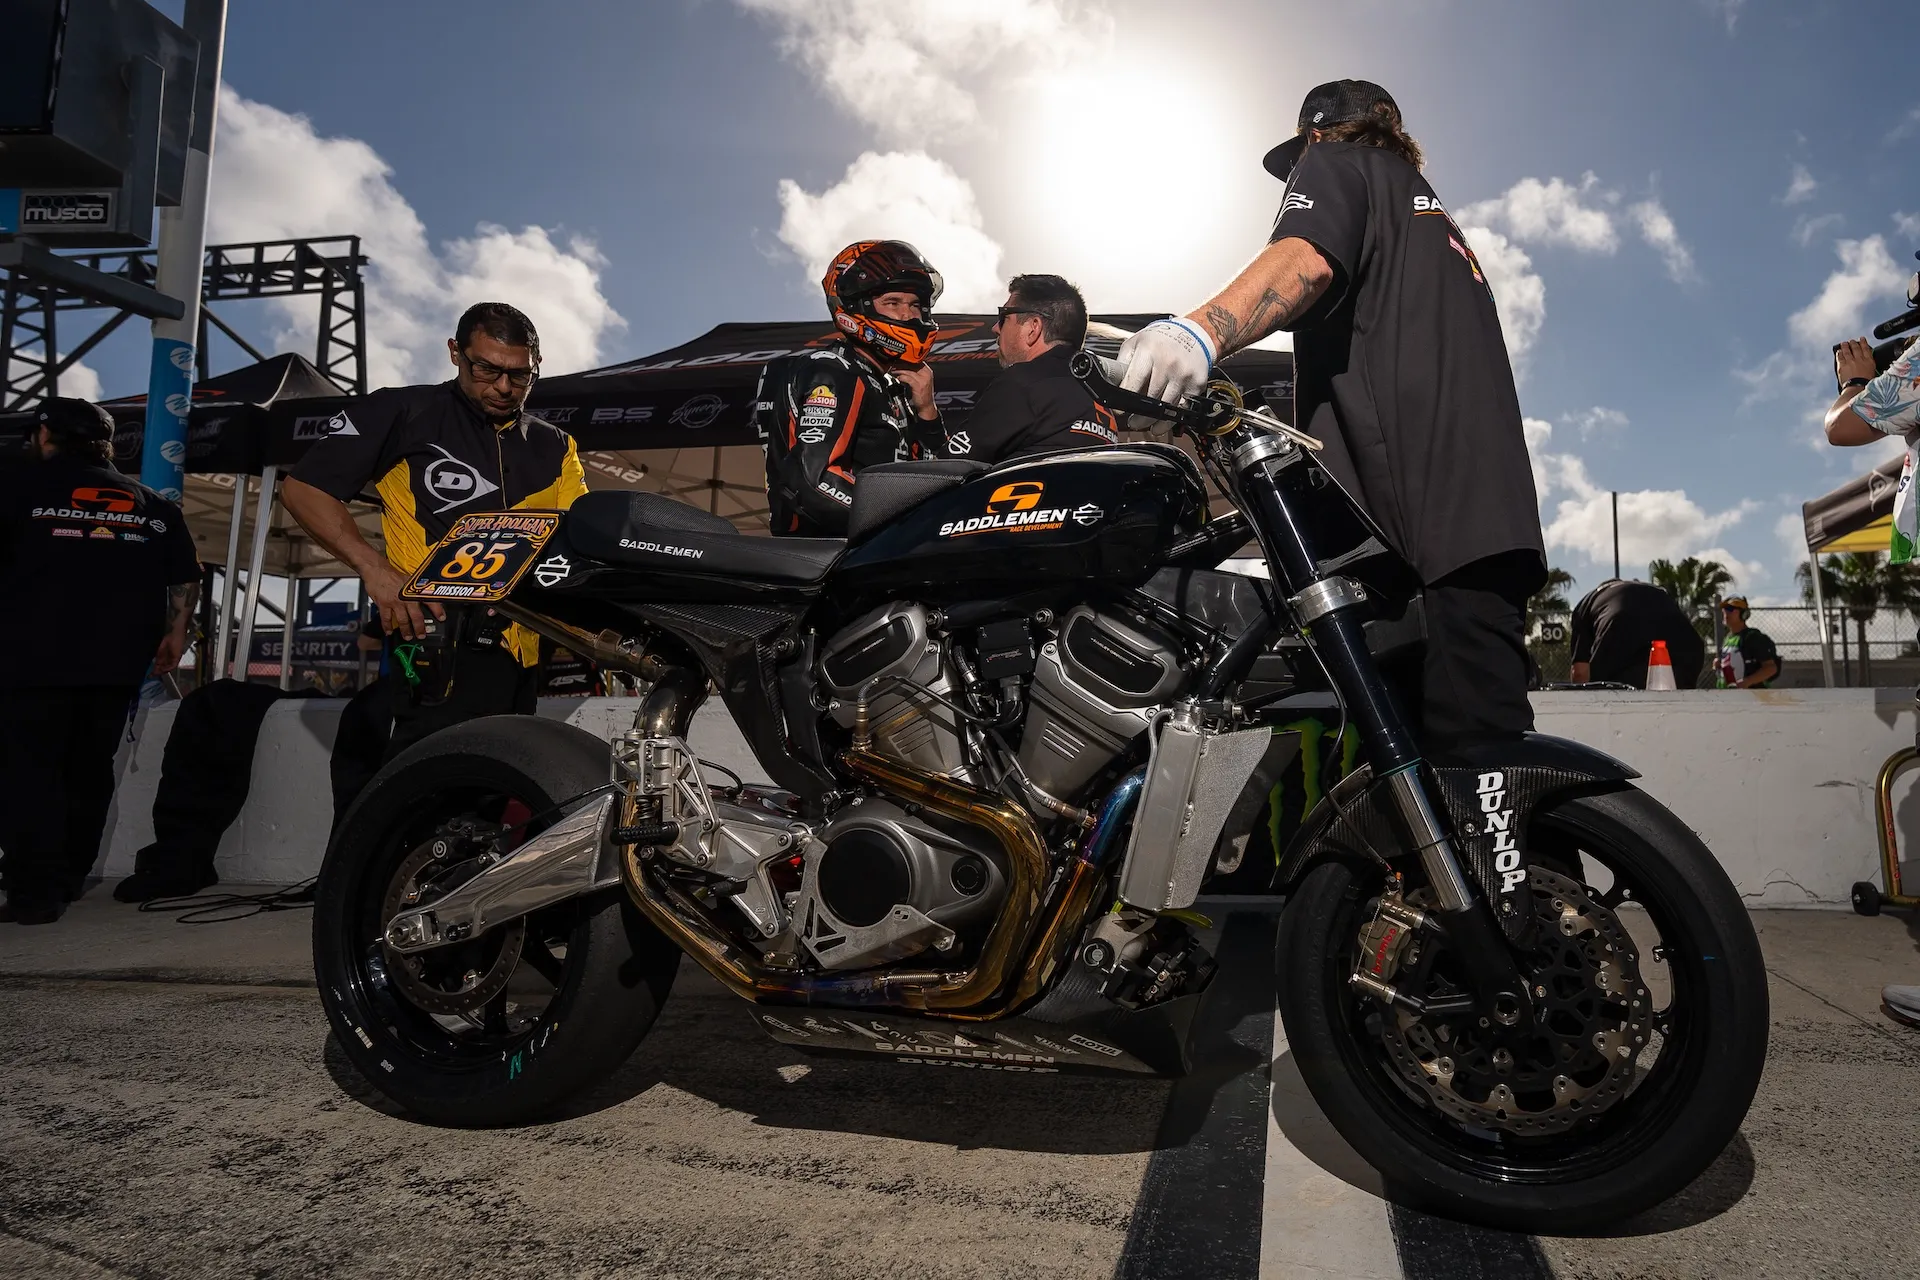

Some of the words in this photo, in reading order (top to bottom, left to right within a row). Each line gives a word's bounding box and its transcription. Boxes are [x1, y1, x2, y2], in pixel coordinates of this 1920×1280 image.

[838, 316, 855, 330] BELL
[591, 406, 655, 421] BS
[801, 417, 832, 425] MOTUL
[31, 507, 147, 525] SADDLEMEN
[938, 508, 1069, 537] SADDLEMEN
[53, 528, 82, 536] MOTUL
[459, 516, 495, 535] SUPER
[491, 516, 549, 535] HOOLIGAN
[1010, 525, 1024, 533] RACE
[1024, 521, 1064, 532] DEVELOPMENT
[619, 538, 704, 559] SADDLEMEN
[440, 541, 518, 580] 85
[1542, 627, 1563, 641] 30
[261, 641, 351, 657] SEURITY
[1476, 771, 1527, 893] DUNLOP
[1371, 928, 1397, 974] brembo
[875, 1042, 1055, 1064] SADDLEMEN
[1072, 1036, 1119, 1056] MOTUL
[897, 1056, 1060, 1074] DUNLOP
